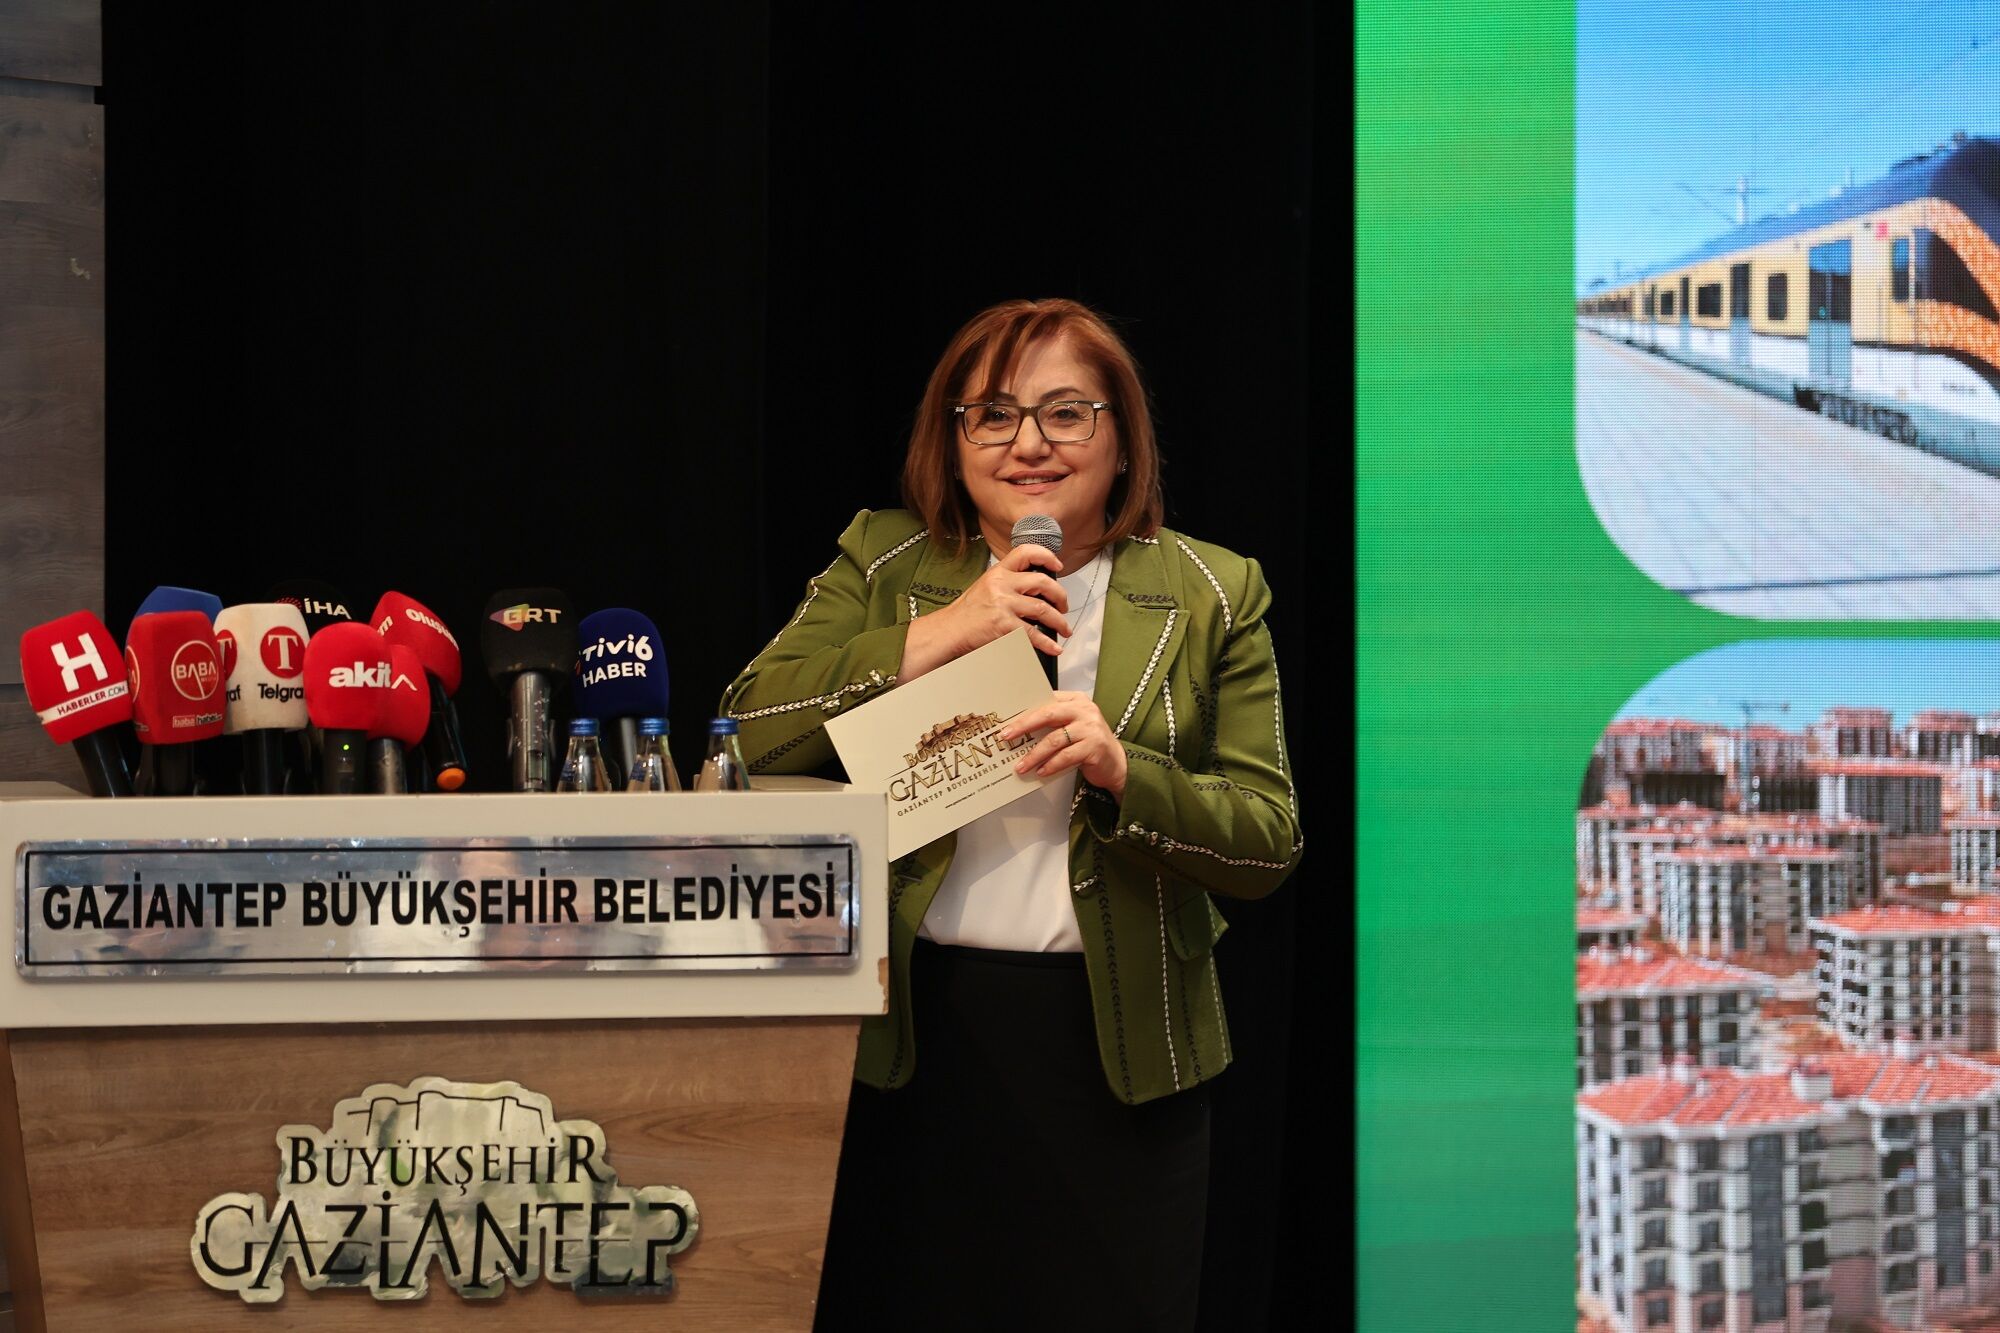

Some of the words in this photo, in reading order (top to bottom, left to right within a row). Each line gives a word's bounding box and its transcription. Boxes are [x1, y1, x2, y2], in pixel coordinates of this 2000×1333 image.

[304, 598, 352, 620] İHA
[503, 607, 561, 625] GRT
[51, 632, 108, 693] H
[268, 634, 298, 670] T
[175, 661, 217, 680] BABA
[328, 661, 391, 688] akit
[582, 661, 647, 688] HABER
[257, 683, 304, 703] Telgra
[889, 725, 1034, 802] GAZİANT
[42, 872, 286, 930] GAZİANTEP
[302, 868, 578, 938] BÜYÜKŞEHİR
[594, 861, 837, 924] BELEDİYESİ
[289, 1134, 605, 1193] BÜYÜKŞEHİR
[199, 1190, 689, 1291] GAZİANTEP
